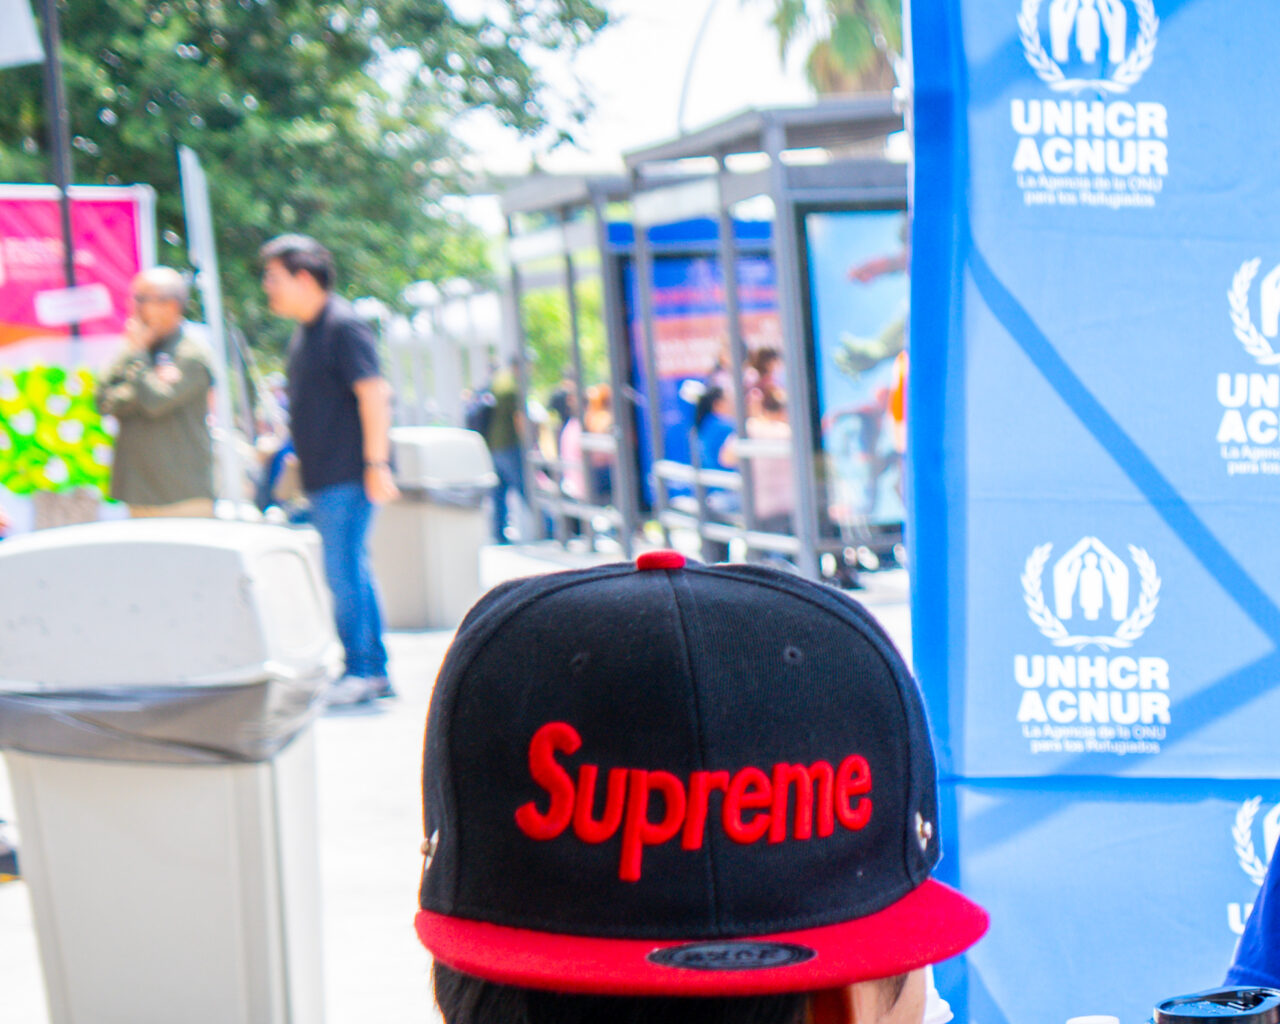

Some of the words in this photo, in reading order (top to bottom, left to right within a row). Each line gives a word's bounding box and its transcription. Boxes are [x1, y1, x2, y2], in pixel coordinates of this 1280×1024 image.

[1010, 99, 1168, 139] UNHCR
[1012, 137, 1168, 175] ACNUR
[1017, 174, 1036, 188] La
[1038, 174, 1090, 190] Agencia
[1093, 176, 1111, 189] de
[1112, 175, 1126, 190] la
[1127, 176, 1163, 192] ONU
[1024, 192, 1055, 206] para
[1057, 190, 1077, 204] los
[1079, 191, 1155, 210] Refugiados
[1220, 445, 1239, 459] La
[1227, 462, 1259, 476] para
[1261, 461, 1280, 474] los
[1014, 654, 1170, 690] UNHCR
[1016, 690, 1171, 724] ACNUR
[1022, 724, 1041, 738] La
[1043, 724, 1096, 739] Agencia
[1098, 725, 1116, 739] de
[1117, 725, 1131, 739] la
[1132, 725, 1166, 740] ONU
[1030, 741, 1062, 754] para
[1063, 739, 1084, 752] los
[1085, 739, 1160, 756] Refugiados
[515, 721, 873, 883] Supreme
